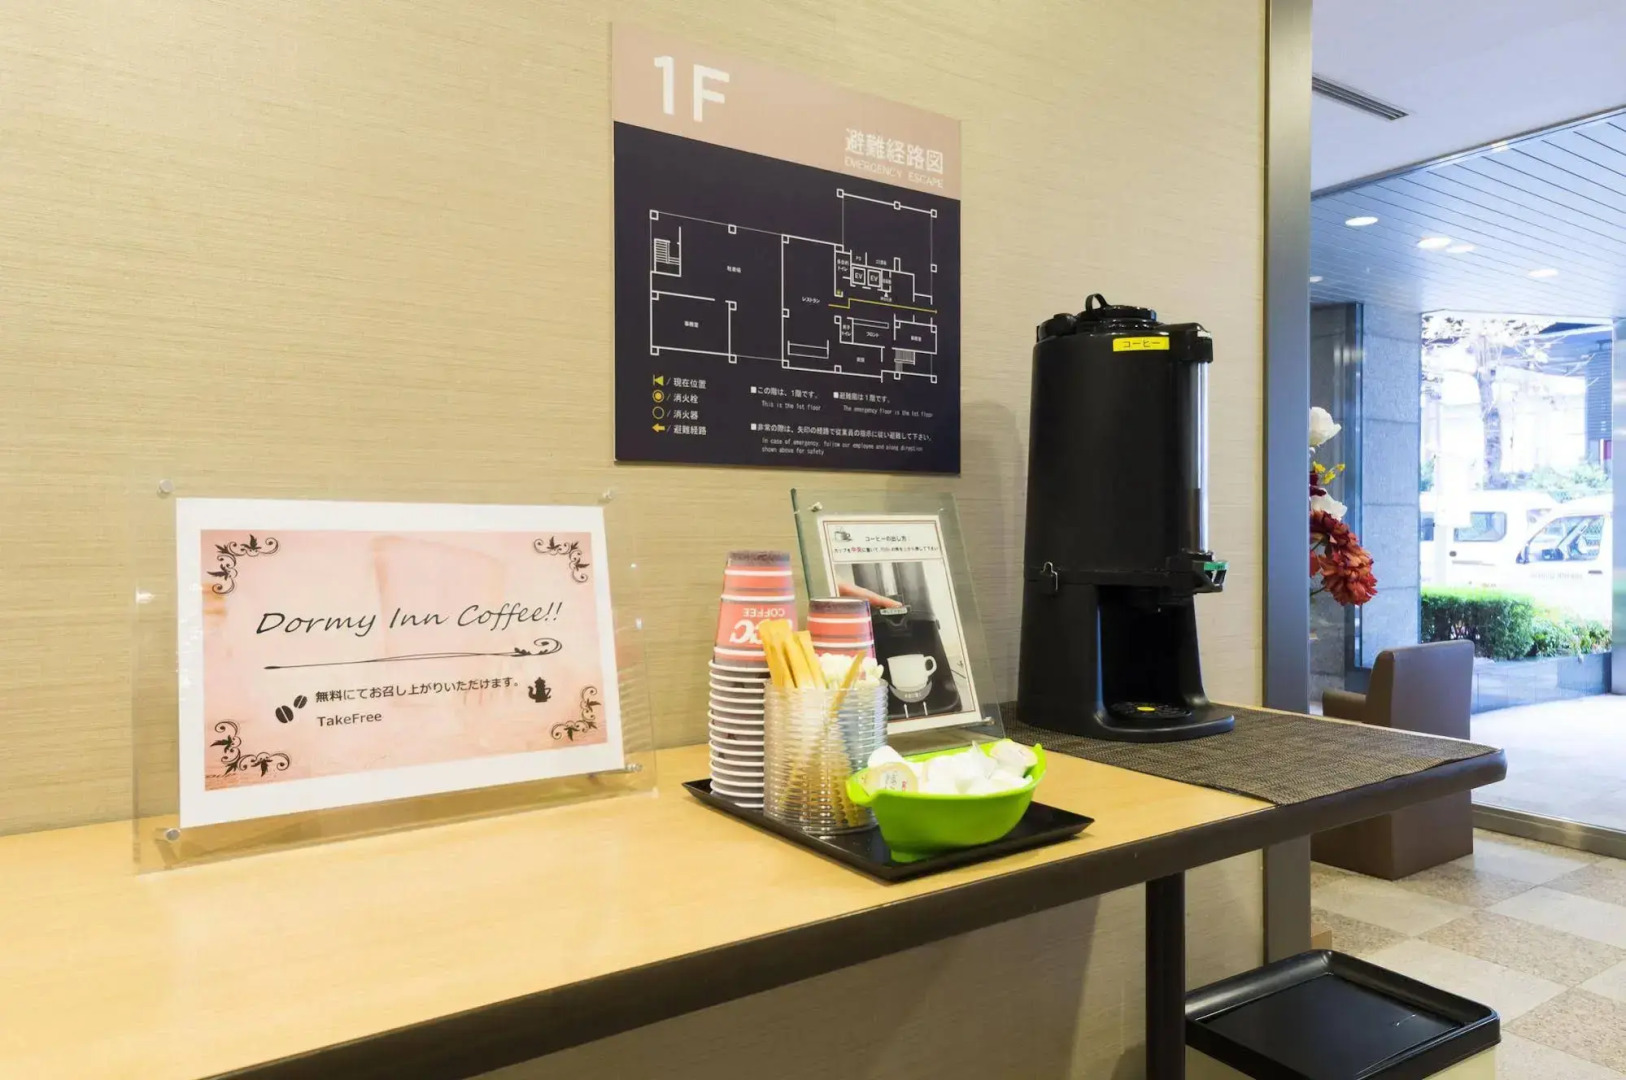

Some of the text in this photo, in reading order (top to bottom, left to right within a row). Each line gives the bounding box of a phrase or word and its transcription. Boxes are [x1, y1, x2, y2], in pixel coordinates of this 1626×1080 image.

[654, 55, 730, 122] 1F
[845, 128, 944, 174] 避難経路図
[844, 156, 944, 188] EMERGENCY ESCAPE
[854, 272, 863, 280] EV
[1123, 340, 1161, 348] コーヒー
[673, 377, 707, 389] 現在位置
[673, 393, 698, 404] 消火栓
[762, 400, 774, 408] This
[673, 409, 699, 420] 消火器
[854, 407, 878, 415] emergency
[673, 424, 707, 435] 避難経路
[807, 448, 824, 456] safety
[743, 607, 786, 618] COFFEE
[256, 601, 564, 637] Dormy Inn Coffee!!
[315, 676, 520, 703] 無料にてお召し上がりいただけます。
[317, 711, 382, 727] TakeFree
